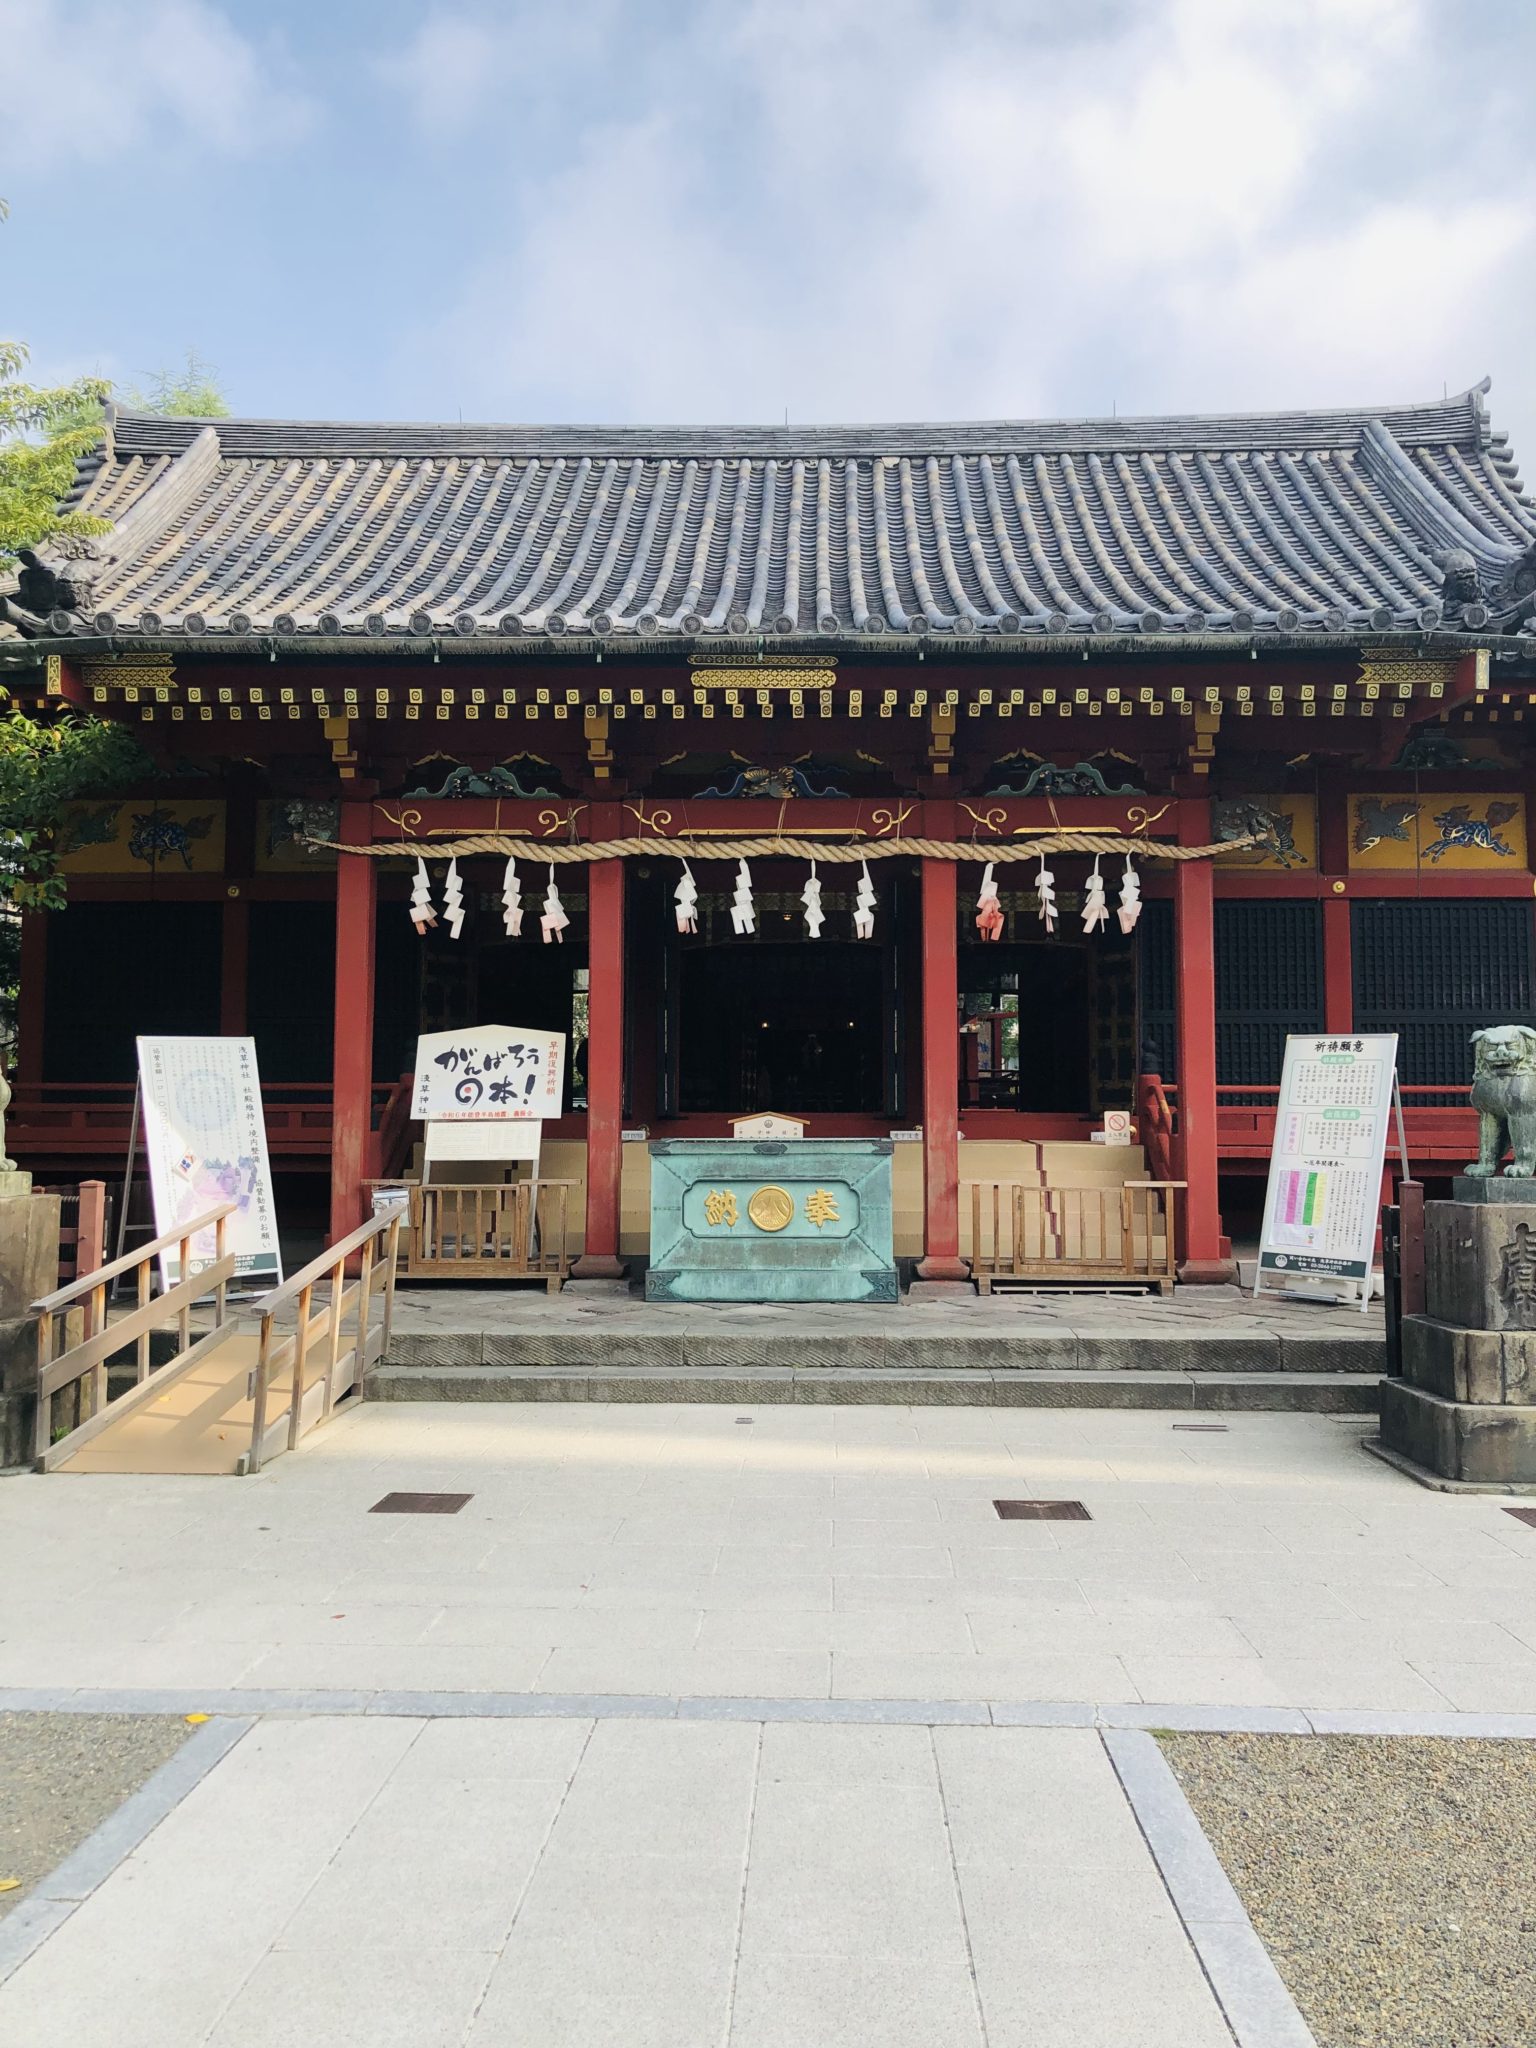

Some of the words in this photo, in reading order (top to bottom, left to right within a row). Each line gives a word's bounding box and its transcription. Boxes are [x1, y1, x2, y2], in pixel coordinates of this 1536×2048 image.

[434, 1044, 540, 1076] がんばろう
[704, 1189, 740, 1227] 納
[804, 1188, 840, 1227] 奉
